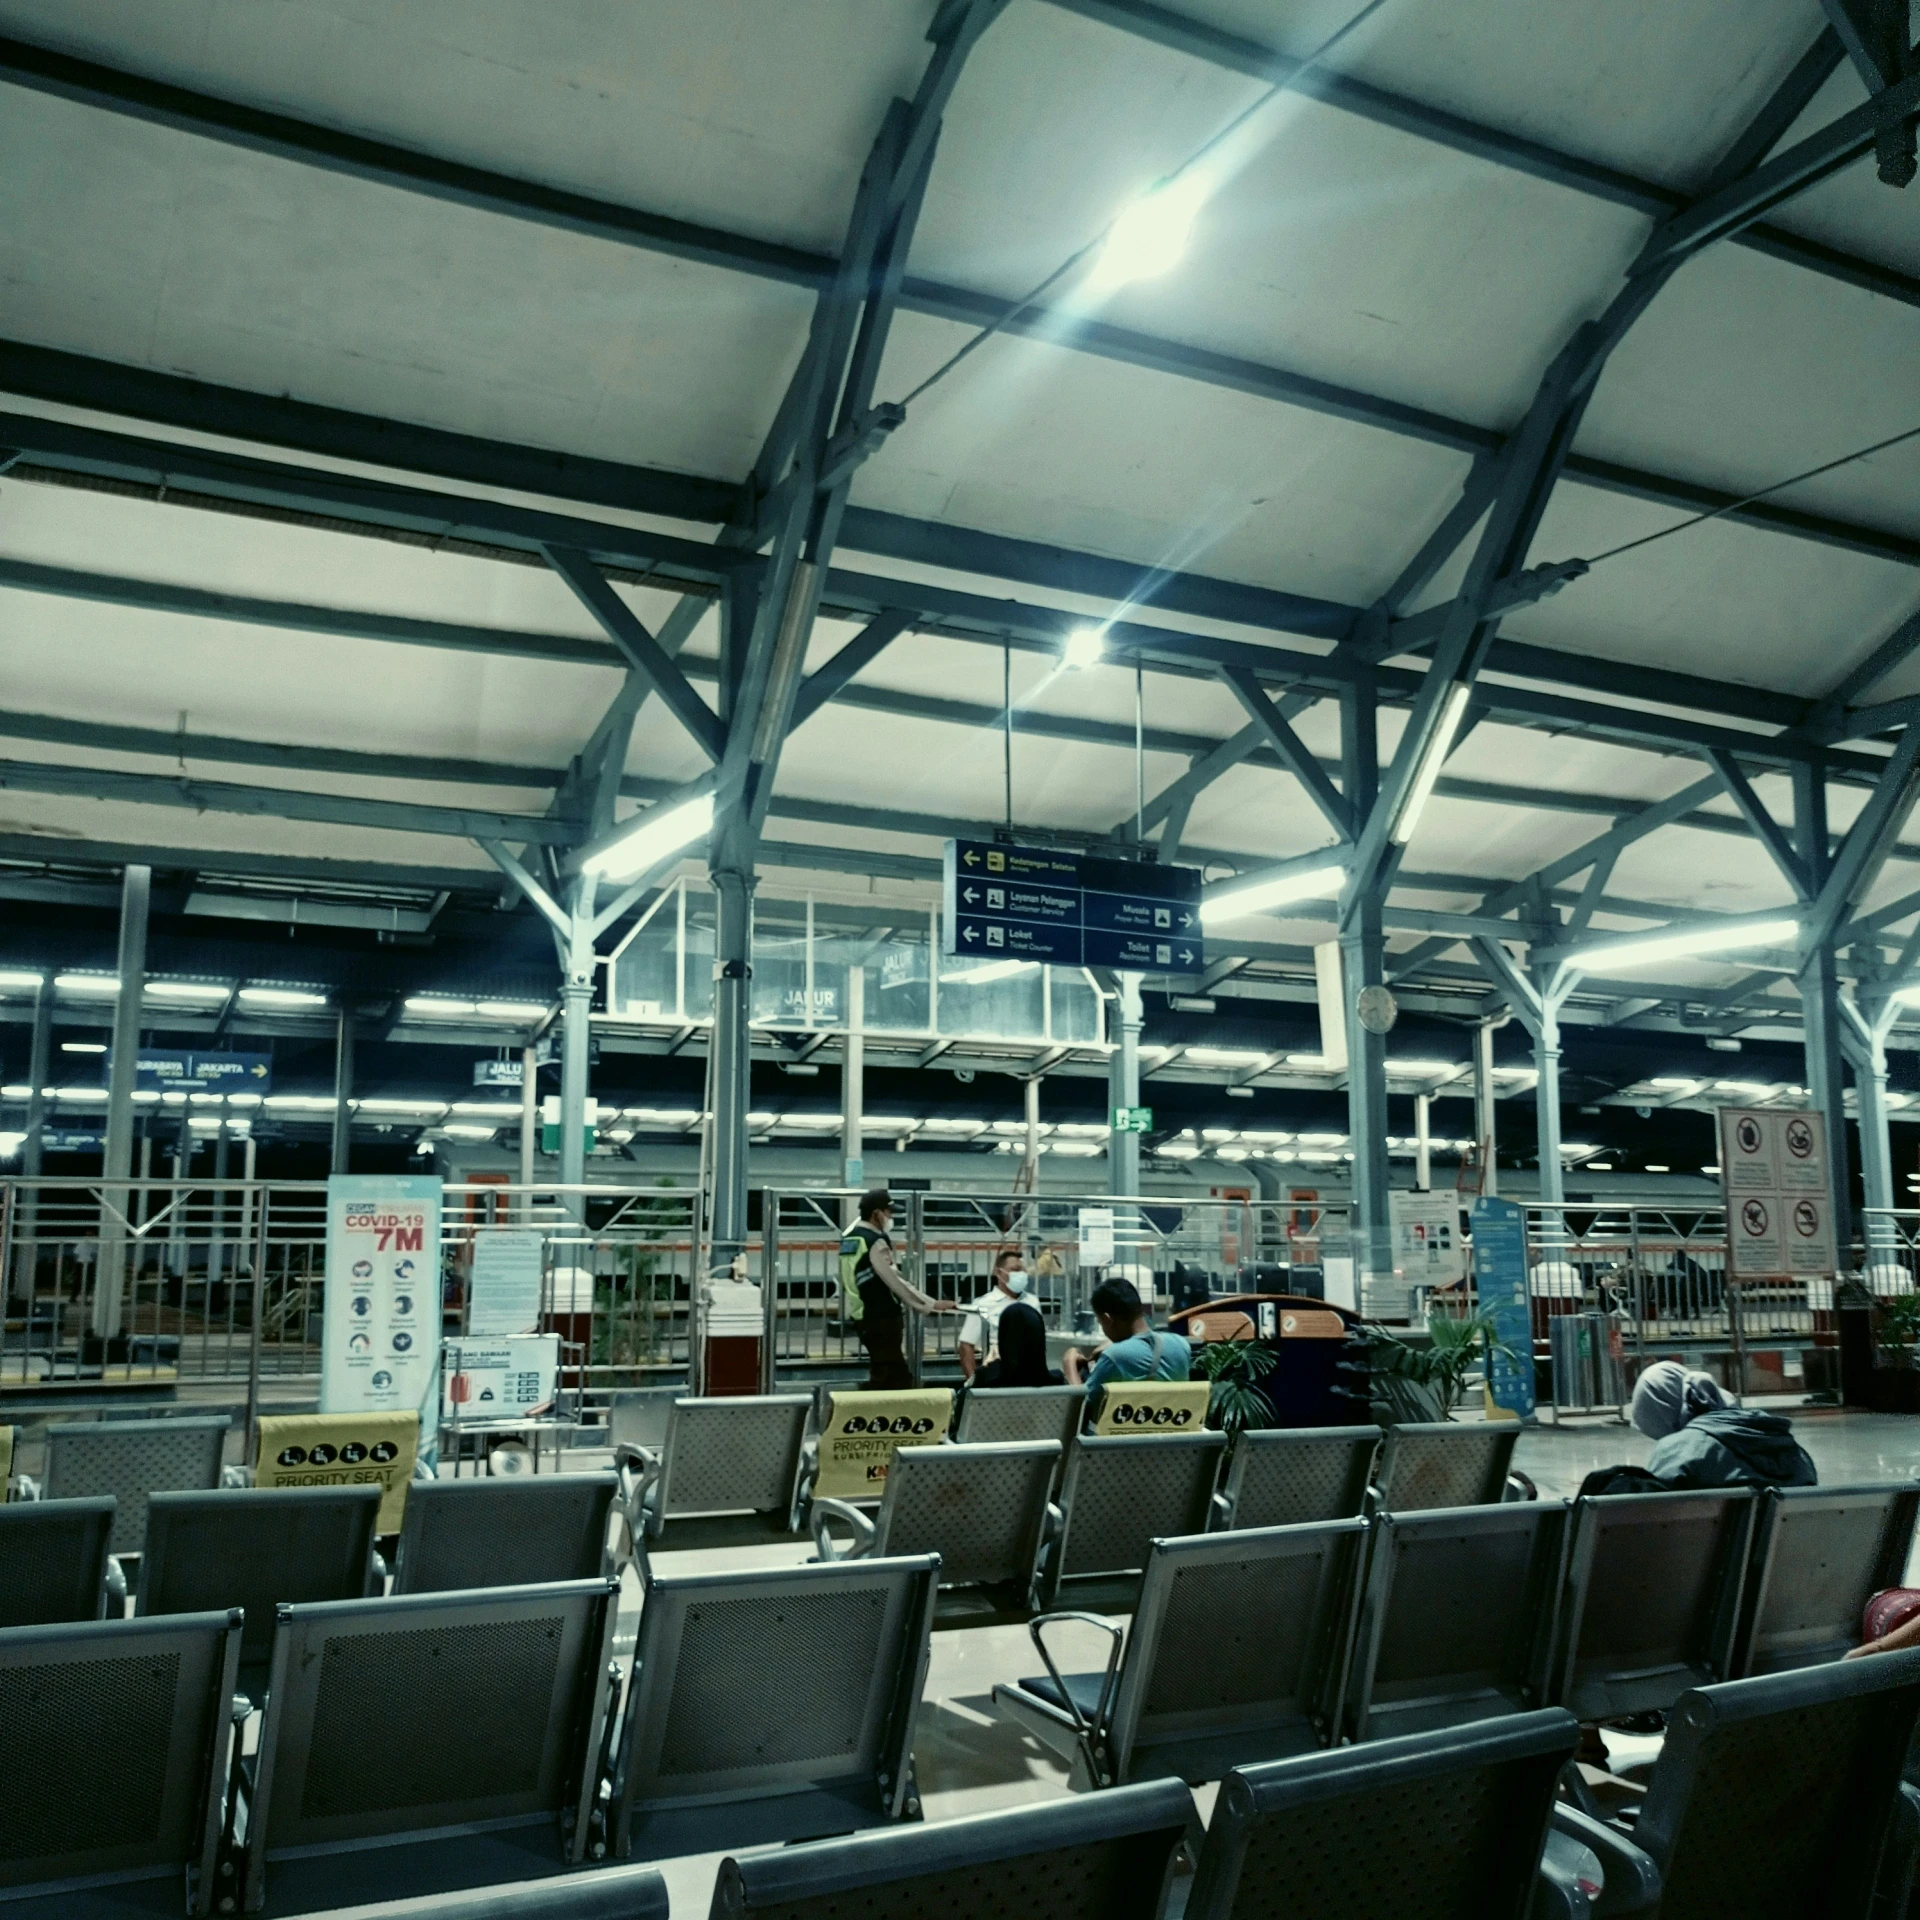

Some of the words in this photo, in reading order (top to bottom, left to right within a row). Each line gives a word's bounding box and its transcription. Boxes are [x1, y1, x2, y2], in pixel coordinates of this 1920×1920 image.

[1010, 891, 1039, 903] Layanan
[1040, 894, 1076, 909] Pelanggan
[1009, 902, 1041, 913] Customer
[1041, 906, 1065, 917] Service
[1009, 929, 1032, 940] Loket
[1010, 940, 1028, 950] Ticket
[1028, 943, 1054, 952] Counter
[1127, 941, 1150, 953] Toilet
[1119, 951, 1150, 962] Restroom
[784, 990, 835, 1006] JAUR
[196, 1063, 244, 1073] JAKARTA
[488, 1062, 522, 1075] JALU
[345, 1215, 424, 1227] COVID-19
[373, 1227, 423, 1251] 7M
[834, 1440, 891, 1452] PRIORITY
[275, 1473, 350, 1487] PRIORITY
[353, 1469, 394, 1484] SEAT
